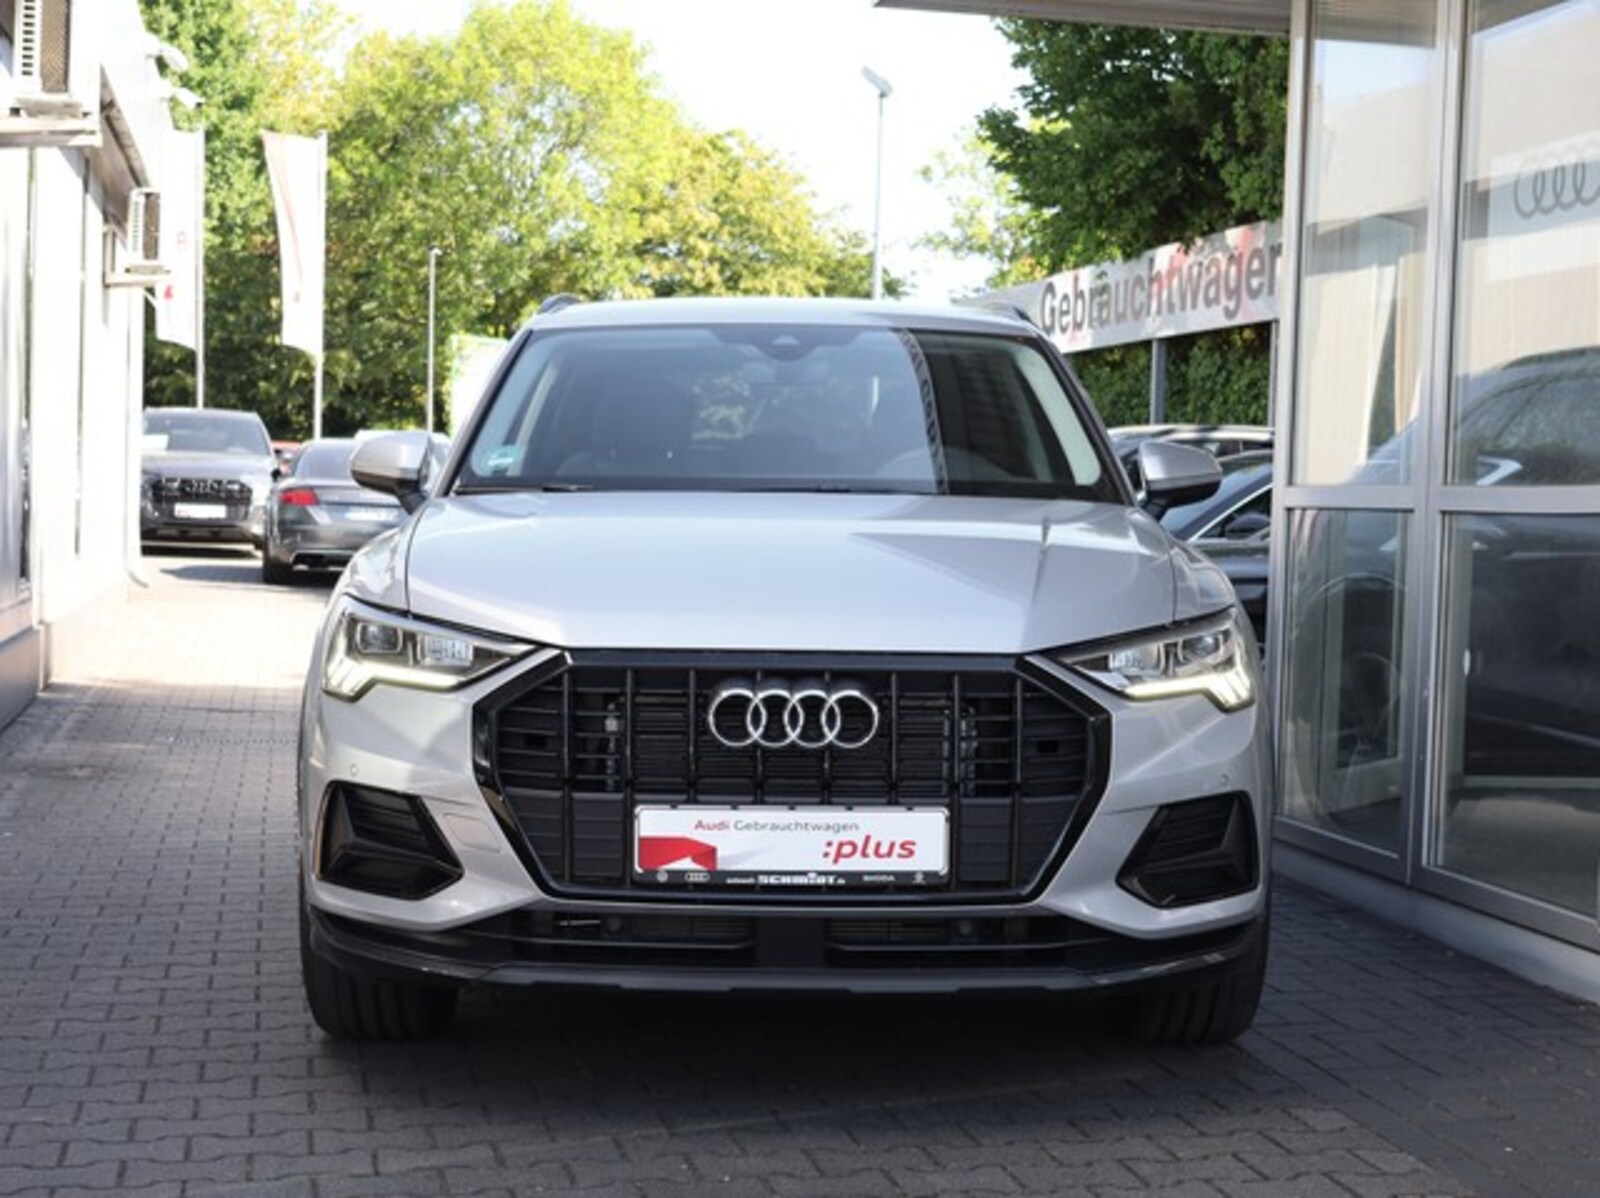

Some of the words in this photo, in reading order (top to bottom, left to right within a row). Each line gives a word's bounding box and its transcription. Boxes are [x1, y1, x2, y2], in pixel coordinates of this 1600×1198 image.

[694, 820, 729, 831] Audi
[733, 820, 860, 833] Gebrauchtwagen
[822, 834, 917, 864] :plus
